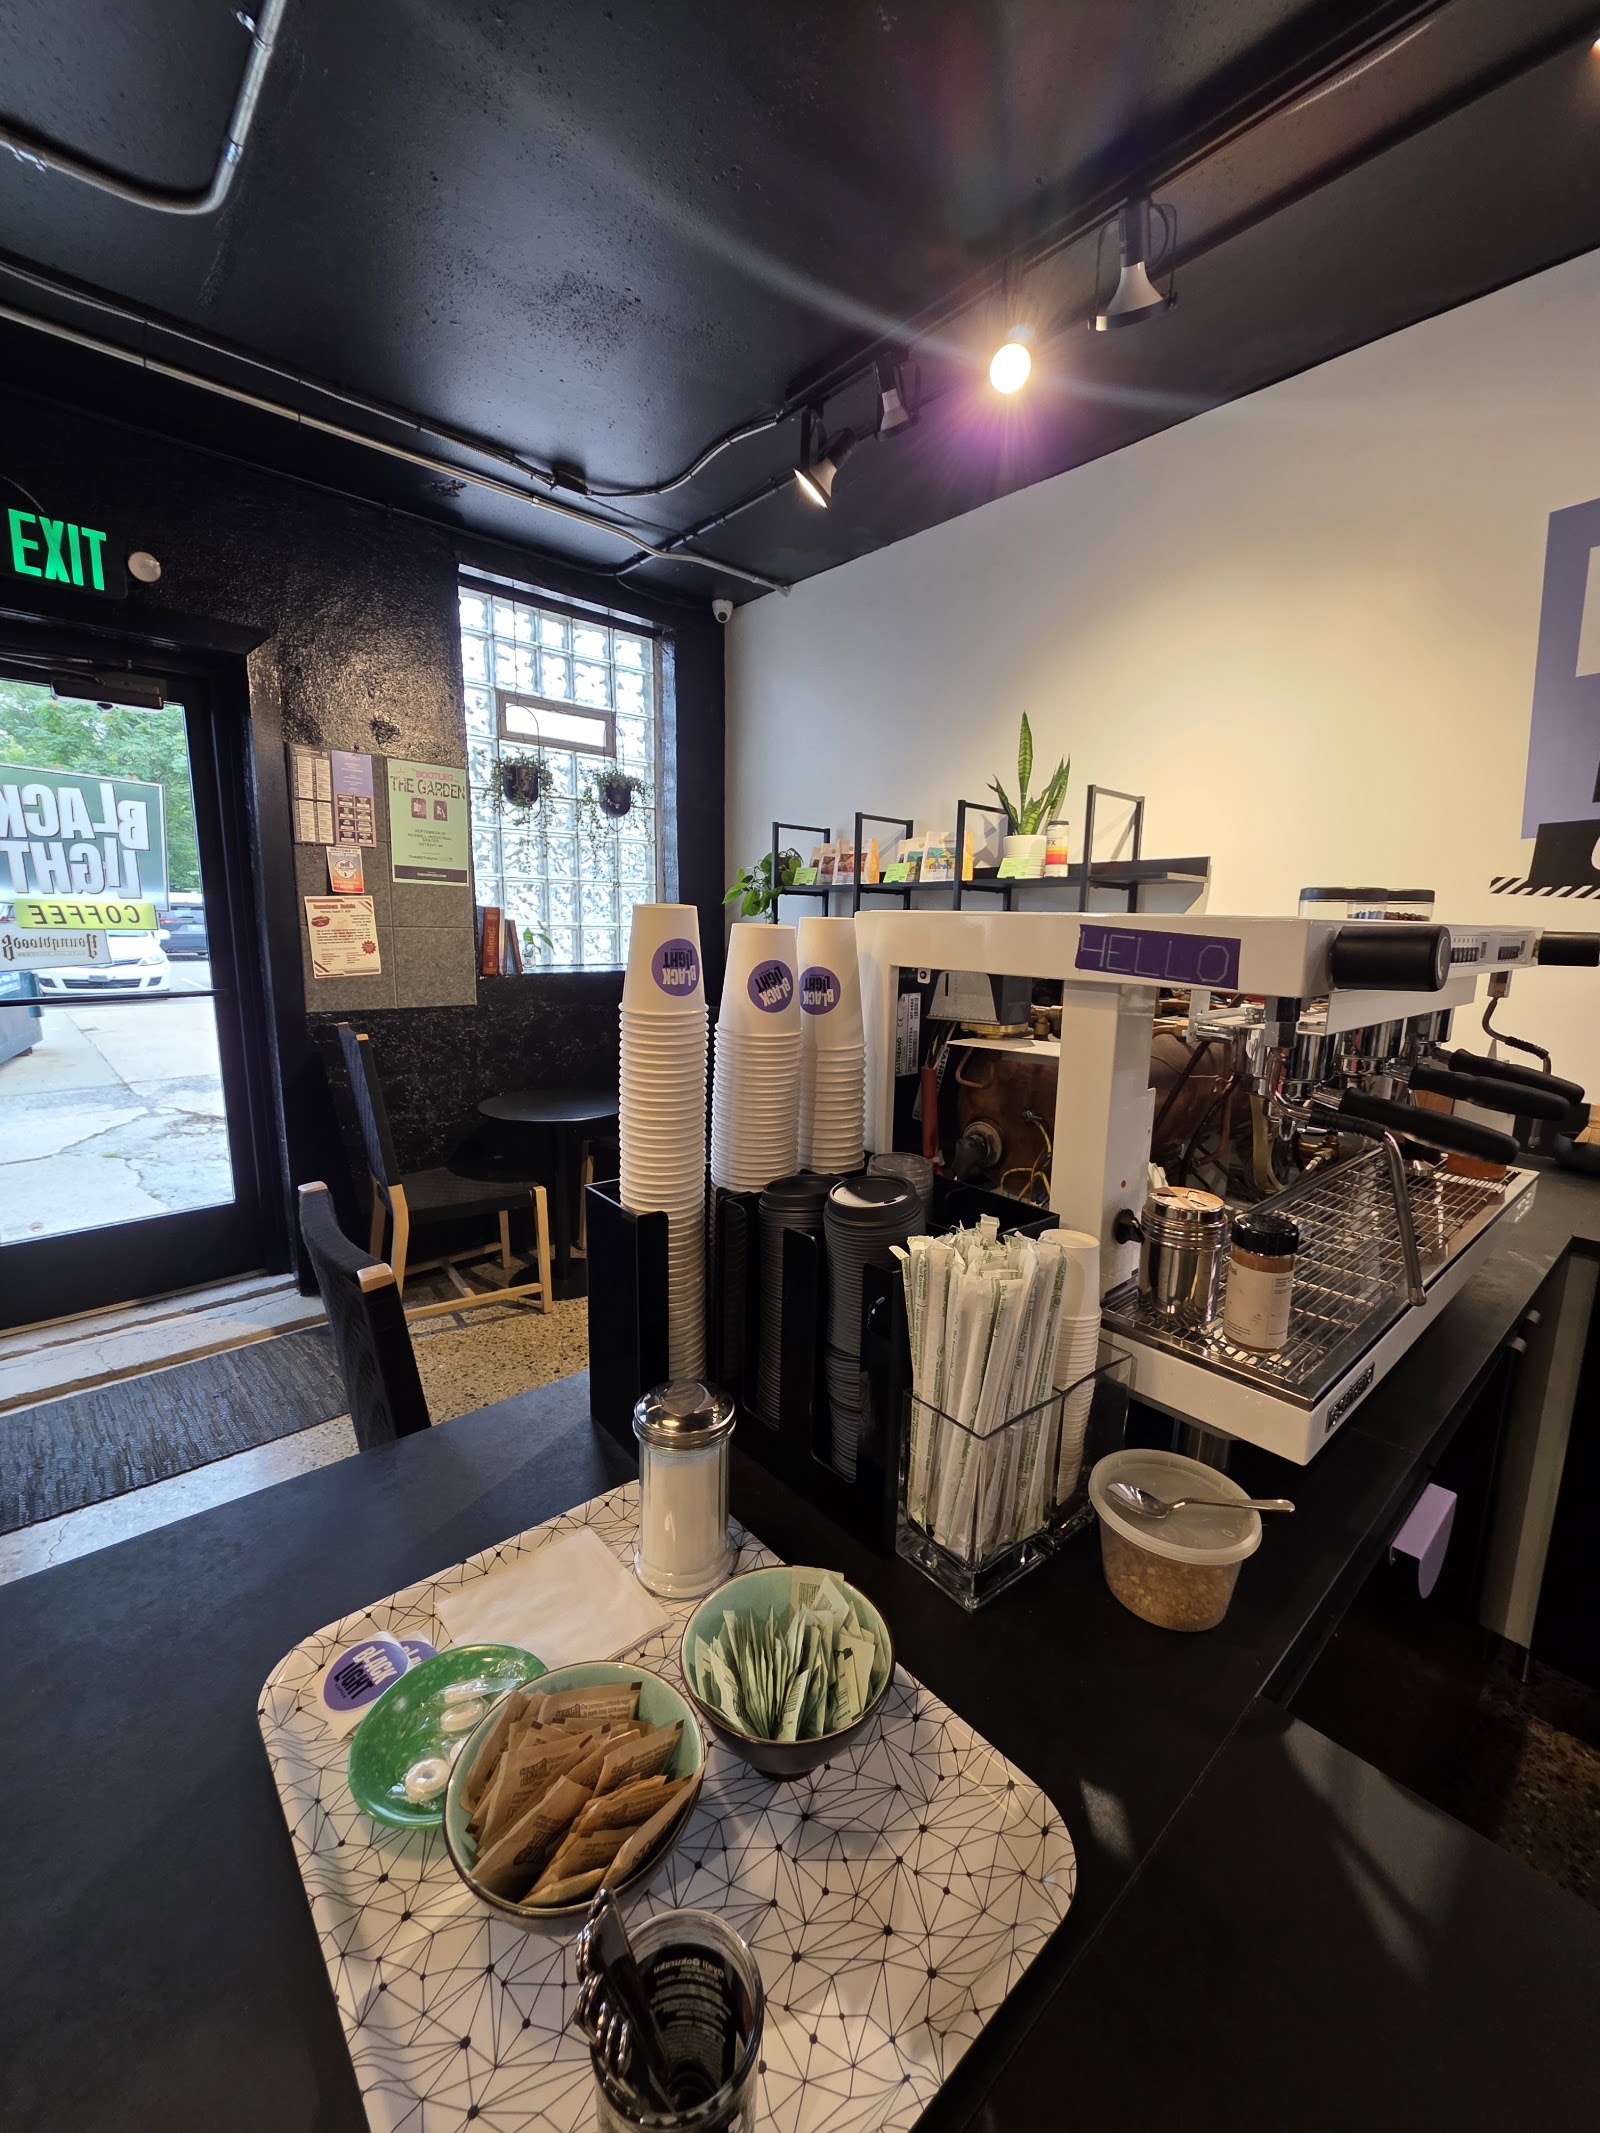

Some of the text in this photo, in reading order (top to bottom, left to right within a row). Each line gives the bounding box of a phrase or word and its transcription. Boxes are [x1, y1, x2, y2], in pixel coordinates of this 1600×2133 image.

[8, 508, 106, 591] EXIT
[390, 776, 466, 800] THE GARDEN
[416, 770, 454, 781] BOOTLEG
[662, 949, 695, 970] LIGHT
[1081, 931, 1229, 983] HELLO
[662, 965, 697, 986] BLACK
[755, 966, 785, 993] LIGHT
[804, 973, 832, 994] LIGHT
[758, 977, 791, 1007] BLACK
[802, 989, 835, 1007] BLACK
[352, 1645, 398, 1686] BLACK
[333, 1661, 375, 1700] LIGHT
